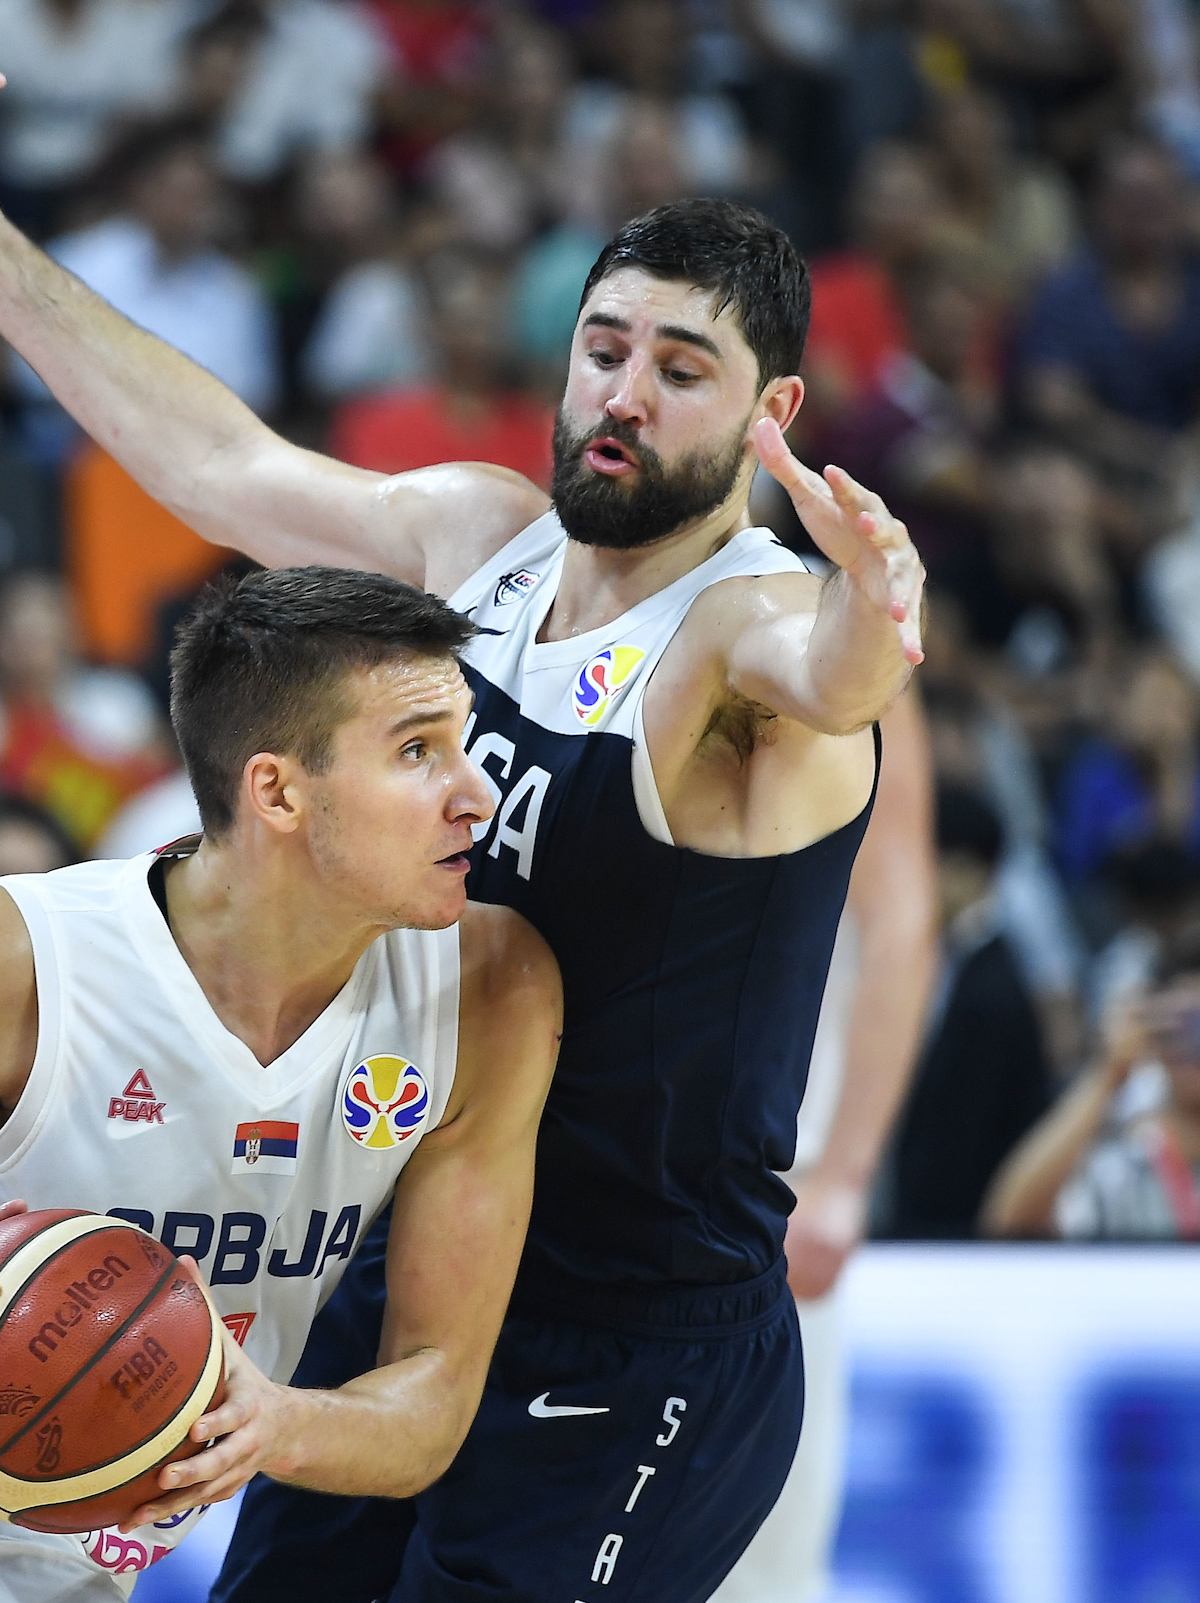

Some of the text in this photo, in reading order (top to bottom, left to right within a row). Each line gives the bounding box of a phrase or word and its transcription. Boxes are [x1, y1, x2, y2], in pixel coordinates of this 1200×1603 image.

[461, 711, 553, 882] SA
[108, 1097, 167, 1124] PEAK
[29, 1255, 131, 1363] molten
[110, 1336, 169, 1399] FIBA
